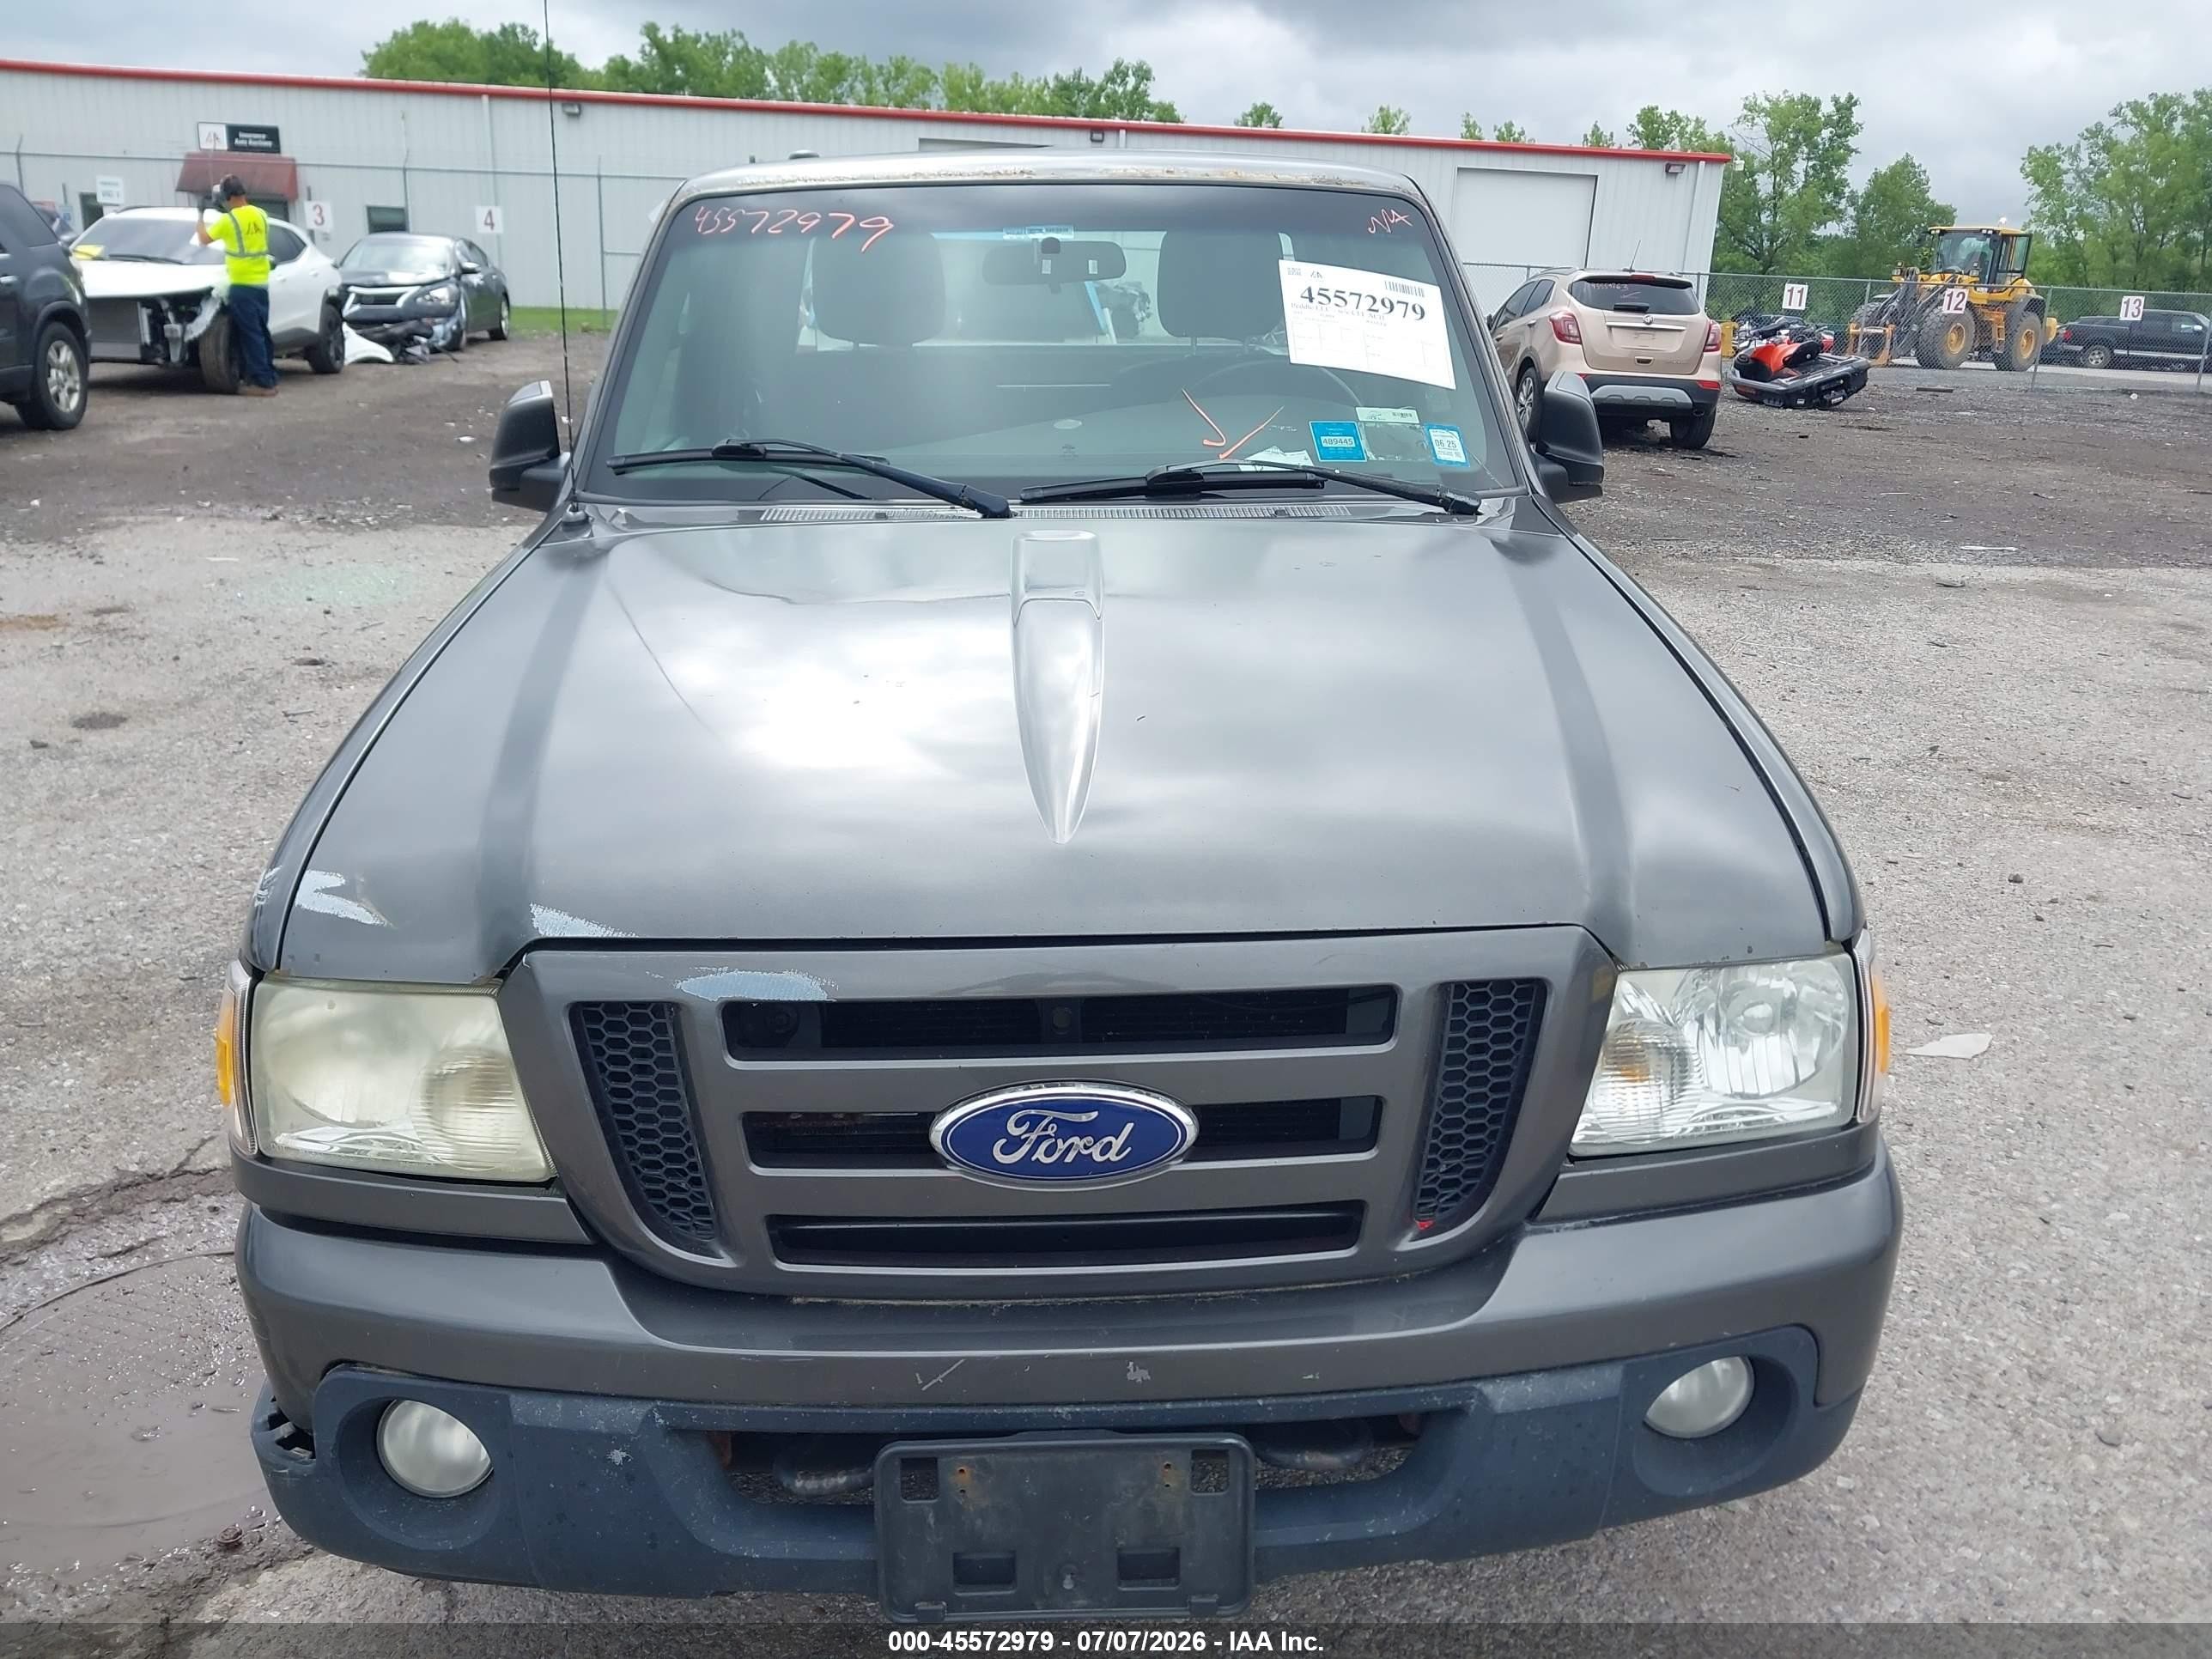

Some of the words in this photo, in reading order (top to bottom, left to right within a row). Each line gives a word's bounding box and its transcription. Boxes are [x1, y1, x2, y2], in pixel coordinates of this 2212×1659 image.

[313, 204, 325, 226] 3
[483, 209, 495, 231] 4
[695, 205, 895, 252] 45572979
[1300, 286, 1425, 321] 45572979
[1787, 286, 1804, 307] 11
[1947, 291, 1966, 311] 12
[2124, 297, 2142, 318] 13
[1435, 439, 1444, 447] 06
[1446, 440, 1457, 448] 25
[993, 1109, 1134, 1164] Ford
